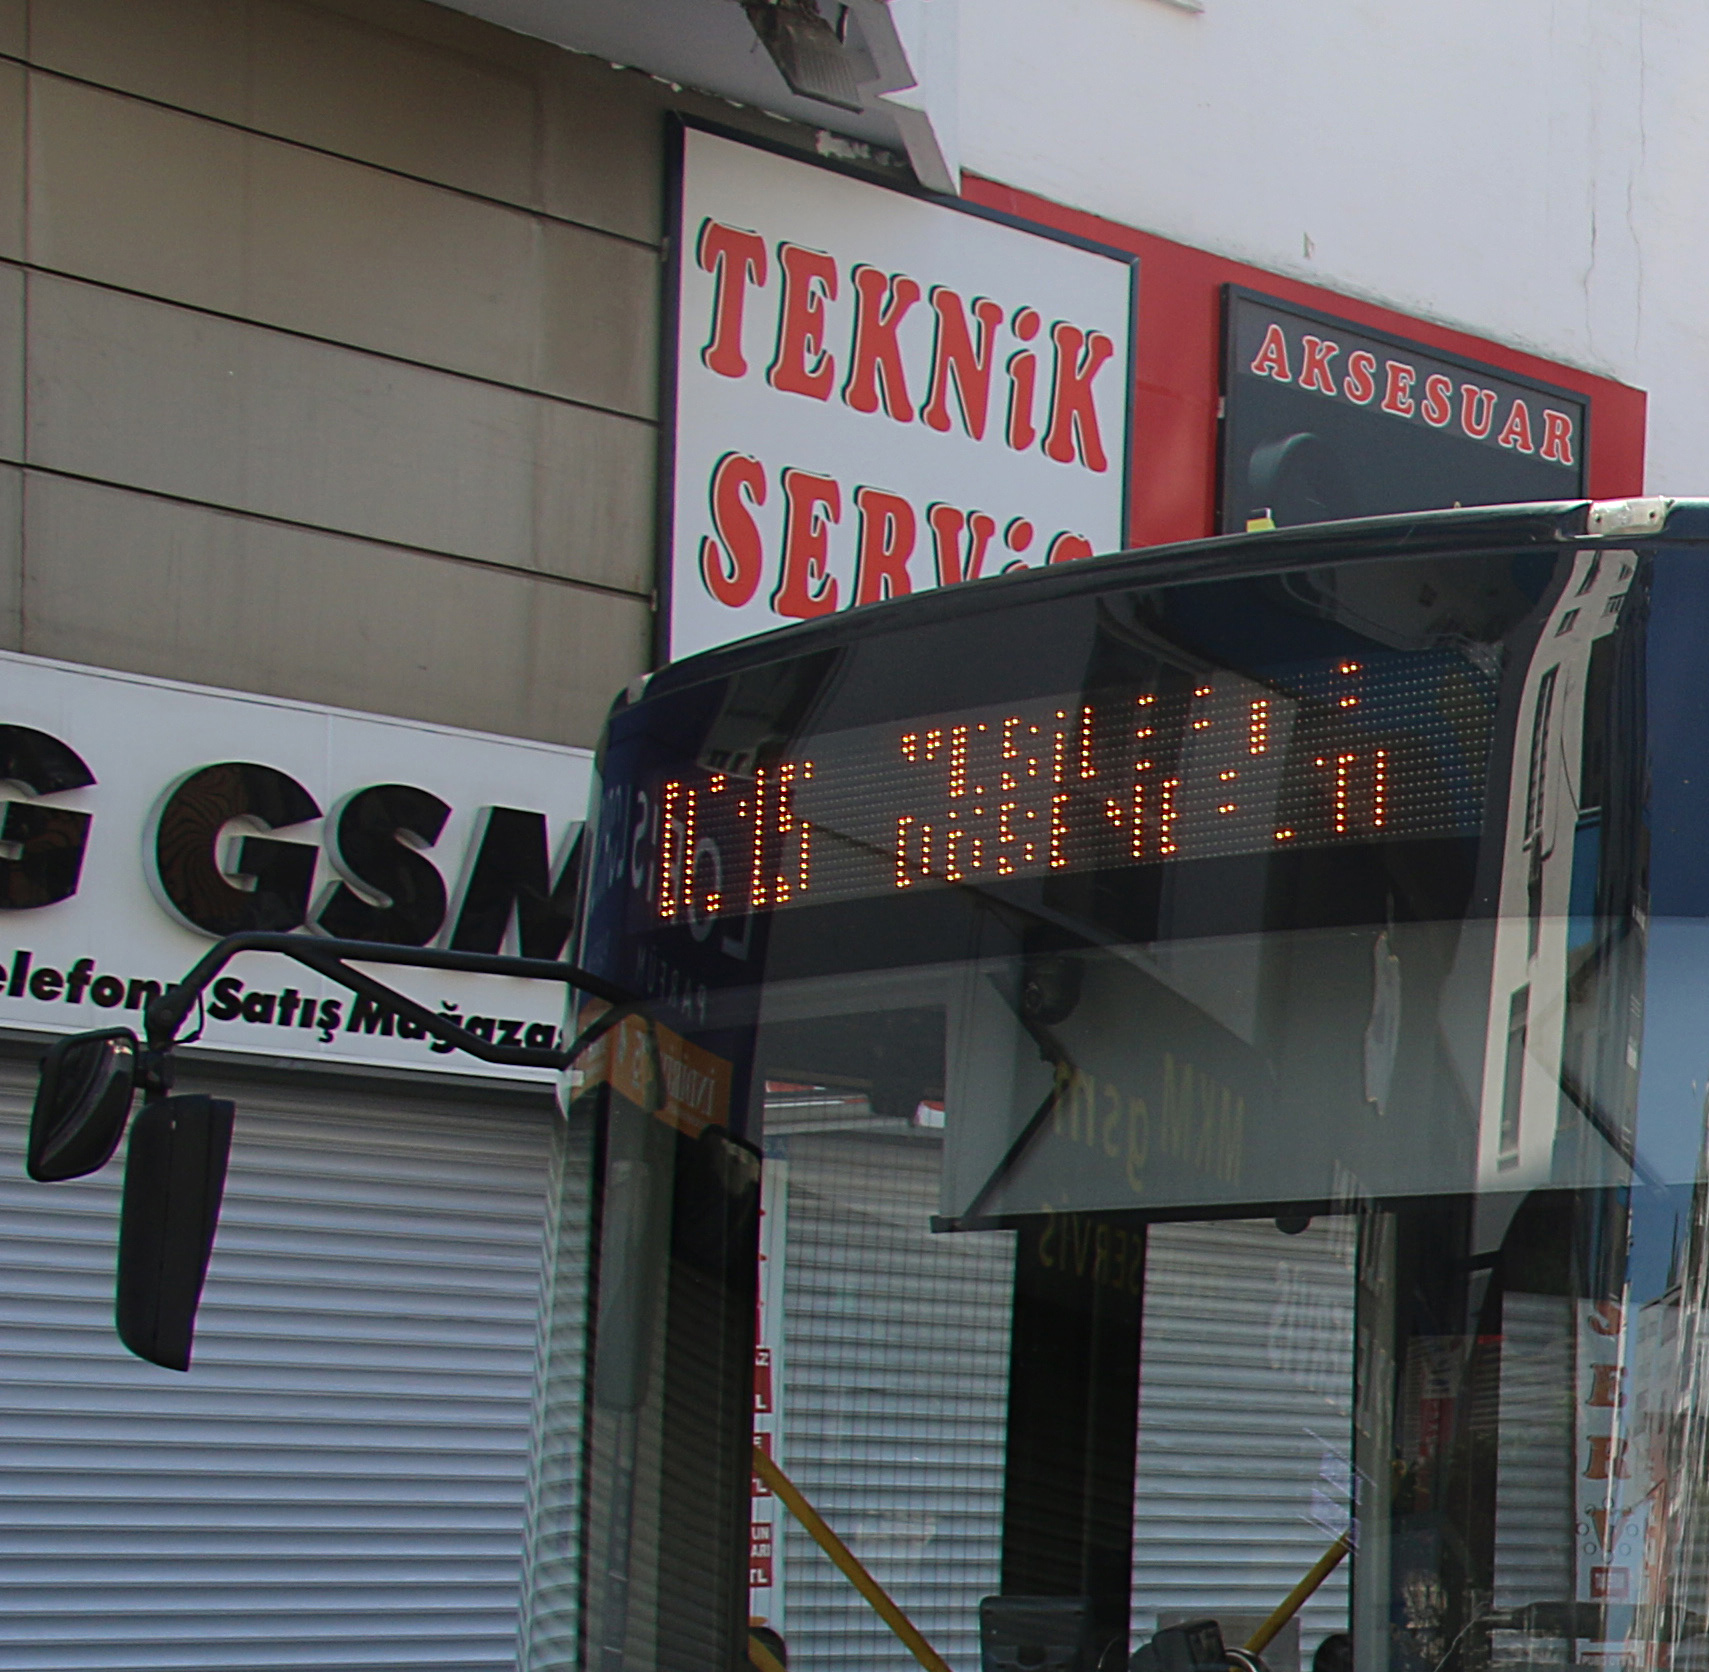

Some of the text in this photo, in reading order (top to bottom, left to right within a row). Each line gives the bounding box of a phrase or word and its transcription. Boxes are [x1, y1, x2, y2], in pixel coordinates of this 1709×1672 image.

[1250, 323, 1575, 465] AKSESUAR
[700, 450, 1096, 620] SERV
[145, 760, 586, 968] GSM
[207, 976, 341, 1042] Satış
